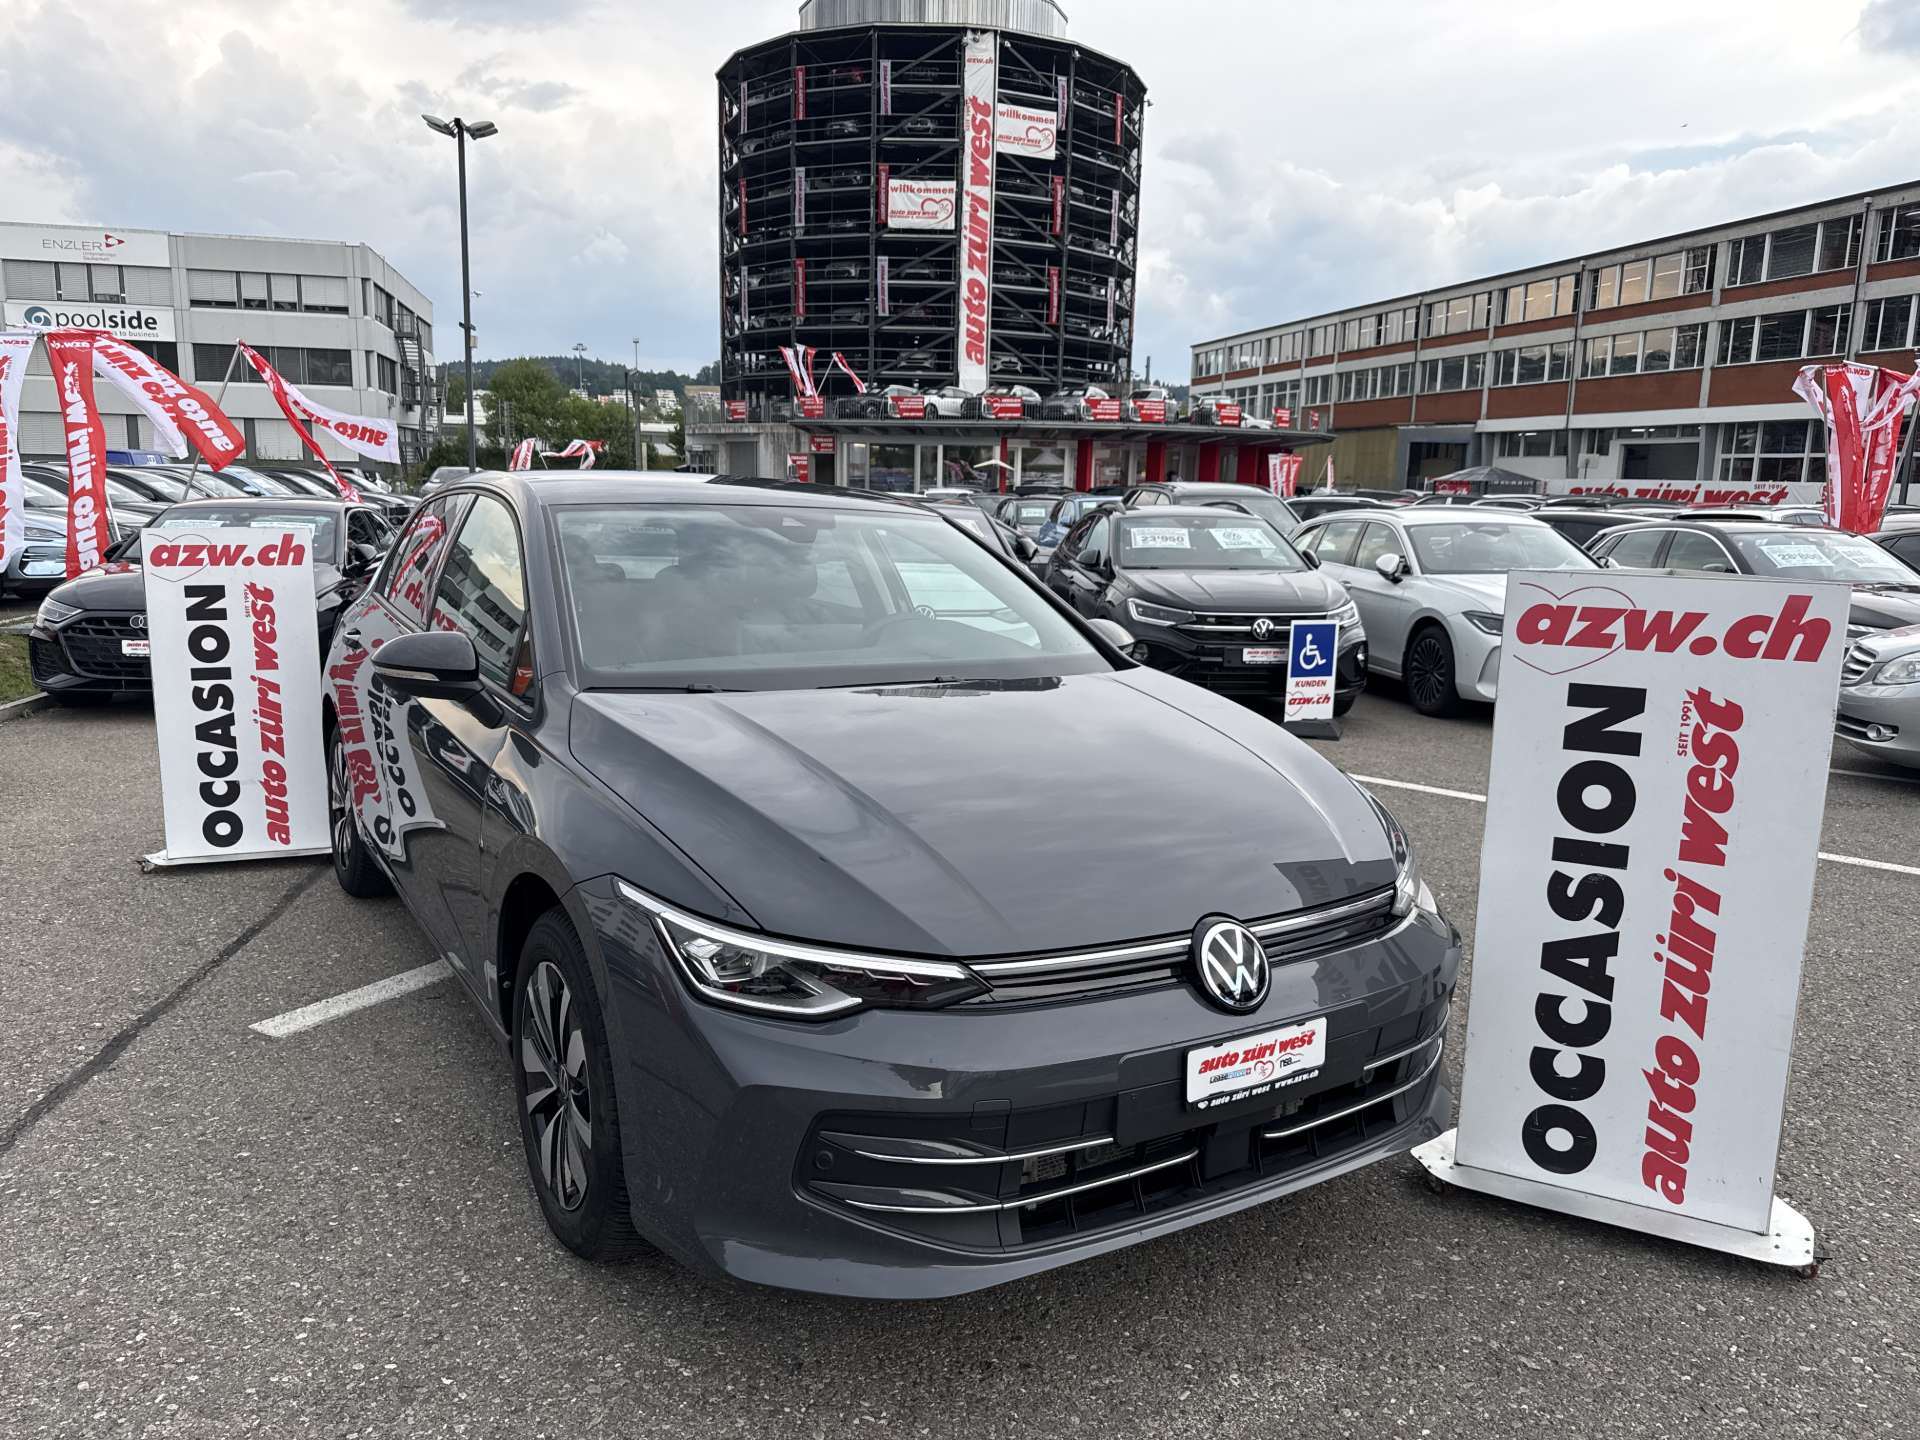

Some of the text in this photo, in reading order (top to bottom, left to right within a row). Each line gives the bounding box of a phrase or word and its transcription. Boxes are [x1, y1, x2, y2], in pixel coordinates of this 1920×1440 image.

[998, 108, 1055, 125] willkommen
[890, 184, 954, 194] willkommen
[42, 239, 102, 251] ENZLER
[963, 95, 992, 365] auto züri west
[56, 309, 157, 330] poolside
[334, 421, 388, 447] auto
[150, 533, 305, 567] azw.ch
[1517, 595, 1832, 662] azw.ch
[183, 584, 244, 848] OCCASION
[244, 582, 292, 846] auto züri west
[1288, 694, 1331, 705] azw.ch
[1677, 700, 1693, 757] SEIT 1991
[1521, 682, 1647, 1175] OCCASION
[1642, 687, 1745, 1205] auto züri west
[1198, 1030, 1316, 1074] auto züri west
